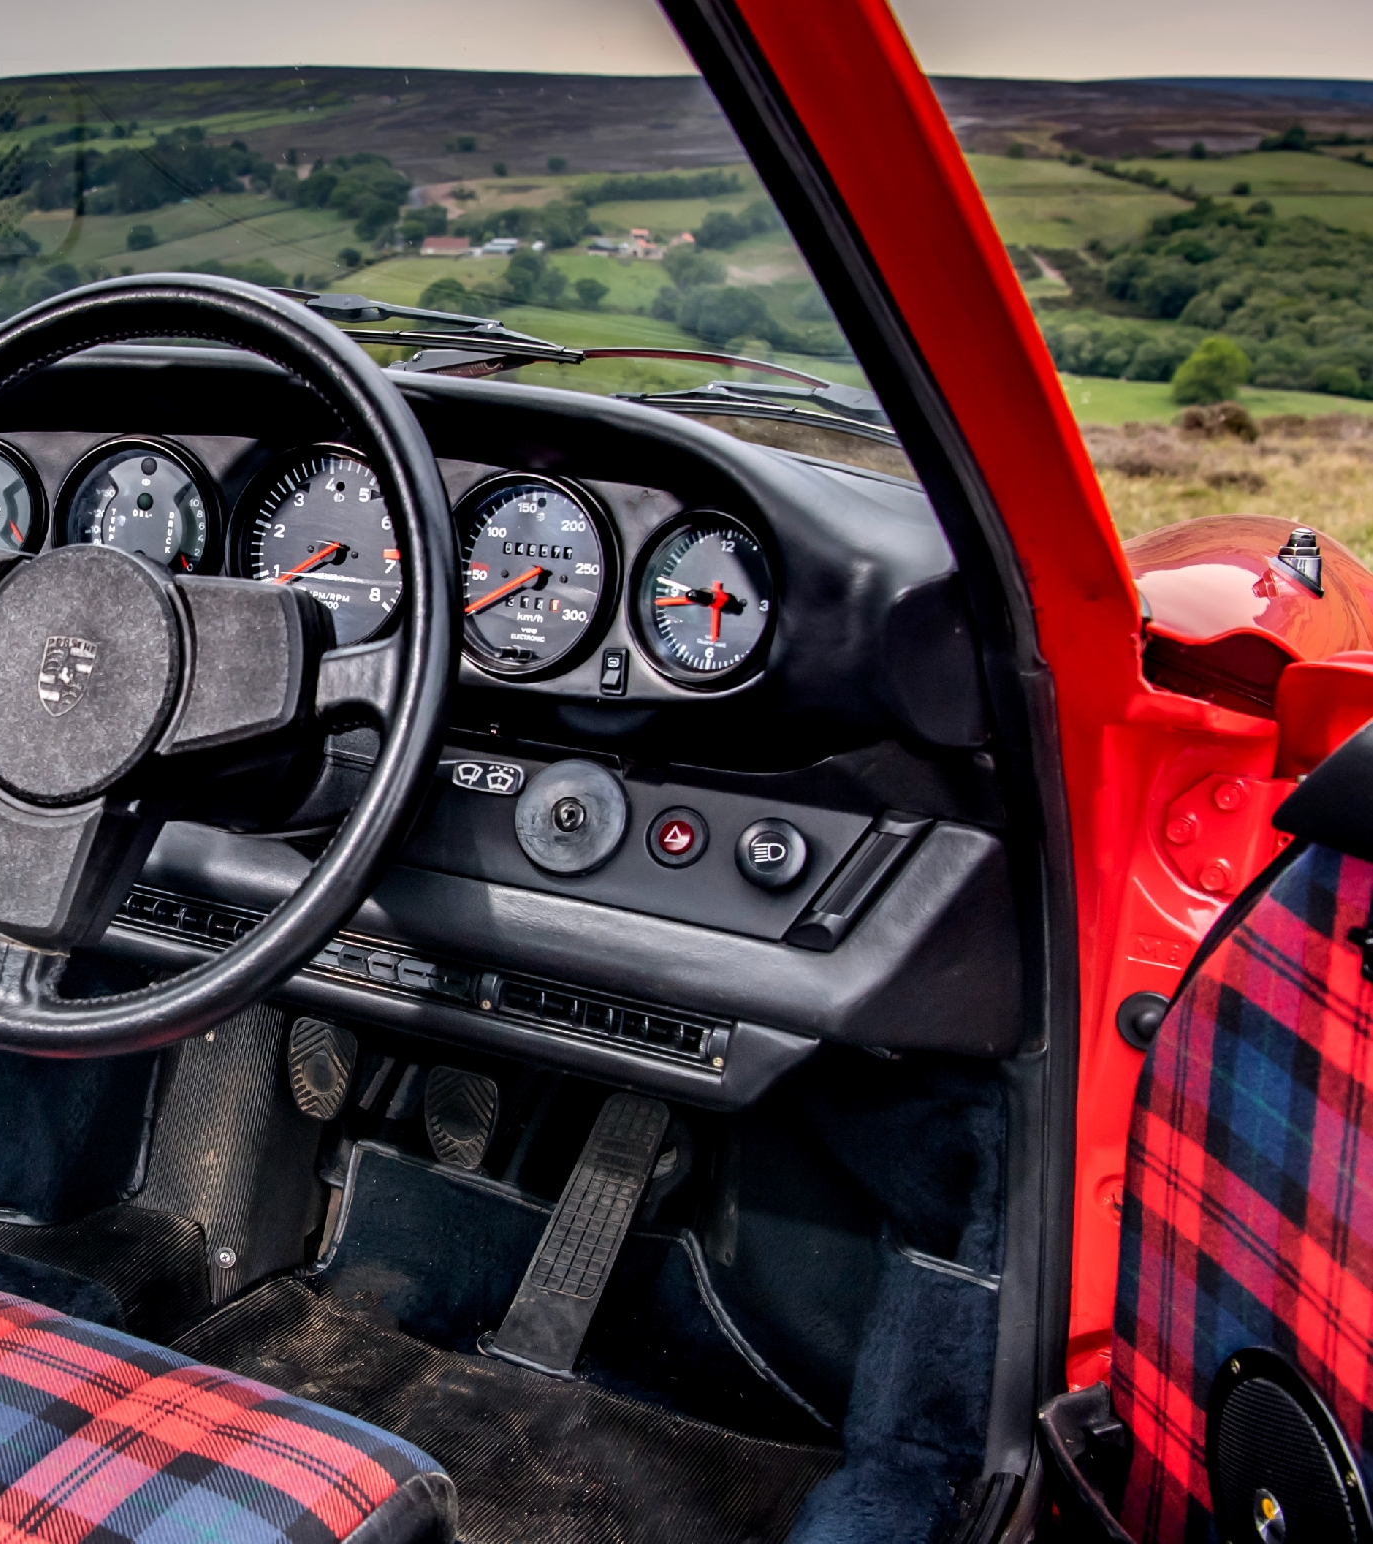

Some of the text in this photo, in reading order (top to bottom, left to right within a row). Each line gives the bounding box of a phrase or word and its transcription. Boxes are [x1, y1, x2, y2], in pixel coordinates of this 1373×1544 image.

[325, 478, 335, 492] 4
[293, 493, 305, 507] 3
[359, 488, 370, 502] 5
[189, 499, 200, 507] 10
[518, 503, 537, 514] 150
[196, 510, 203, 518] 8
[108, 508, 116, 541] TEMP
[199, 521, 205, 531] 6
[381, 516, 392, 530] 6
[561, 519, 586, 532] 200
[164, 511, 175, 554] DRUCK
[273, 524, 286, 539] 2
[487, 526, 507, 538] 100
[720, 541, 735, 553] 12
[273, 564, 280, 577] 1
[385, 559, 397, 573] 7
[575, 563, 599, 575] 250
[472, 569, 488, 580] 50
[369, 588, 381, 602] 8
[759, 600, 769, 612] 3
[517, 611, 543, 623] km/h
[561, 608, 587, 621] 300
[704, 647, 714, 659] 6
